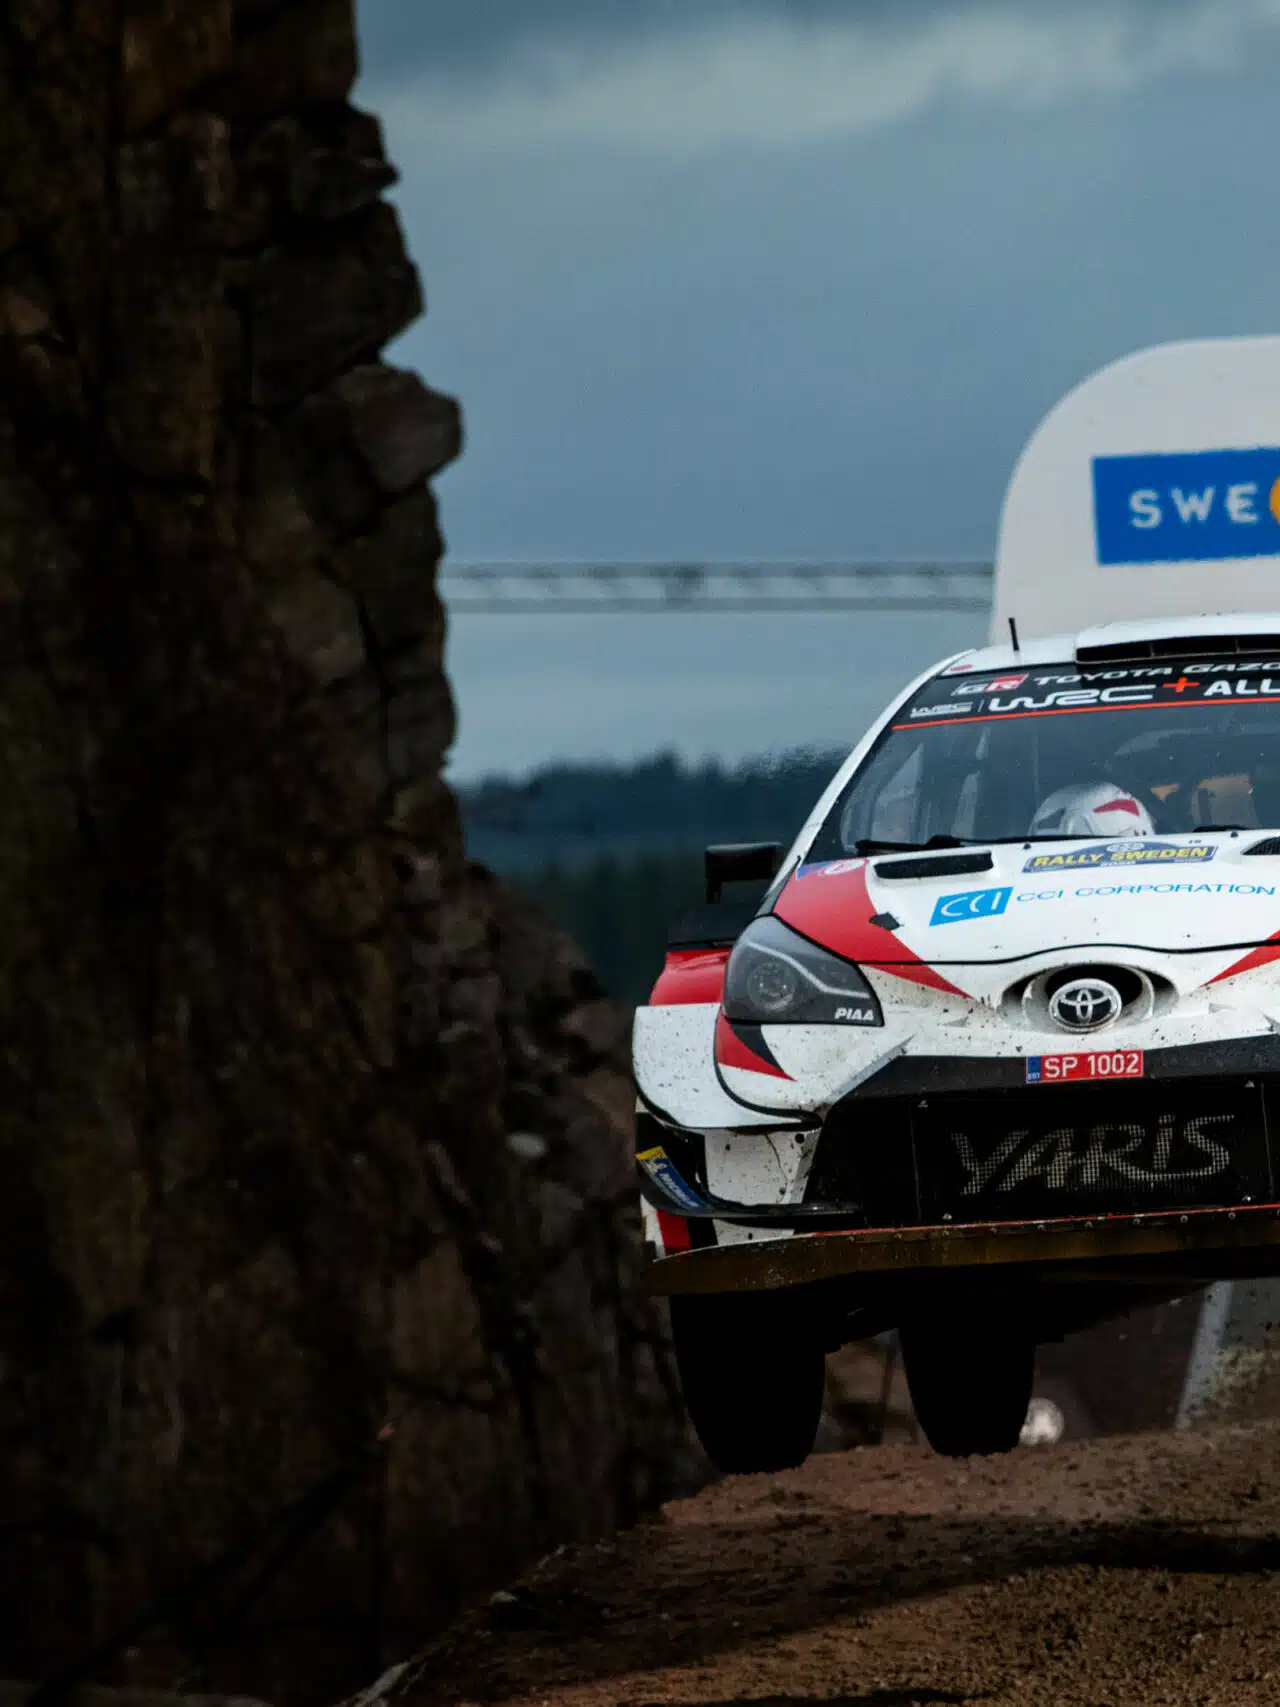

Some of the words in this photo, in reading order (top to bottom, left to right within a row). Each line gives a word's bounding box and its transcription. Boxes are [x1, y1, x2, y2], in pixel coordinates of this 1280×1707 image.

[1034, 667, 1173, 687] TOYOTA
[1033, 853, 1104, 867] RALLY
[1110, 847, 1209, 862] SWEDEN
[1016, 889, 1064, 902] CCI
[1074, 883, 1277, 897] CORPORATION
[834, 1007, 875, 1021] PIAA
[1044, 1056, 1079, 1079] SP
[1087, 1052, 1140, 1076] 1002
